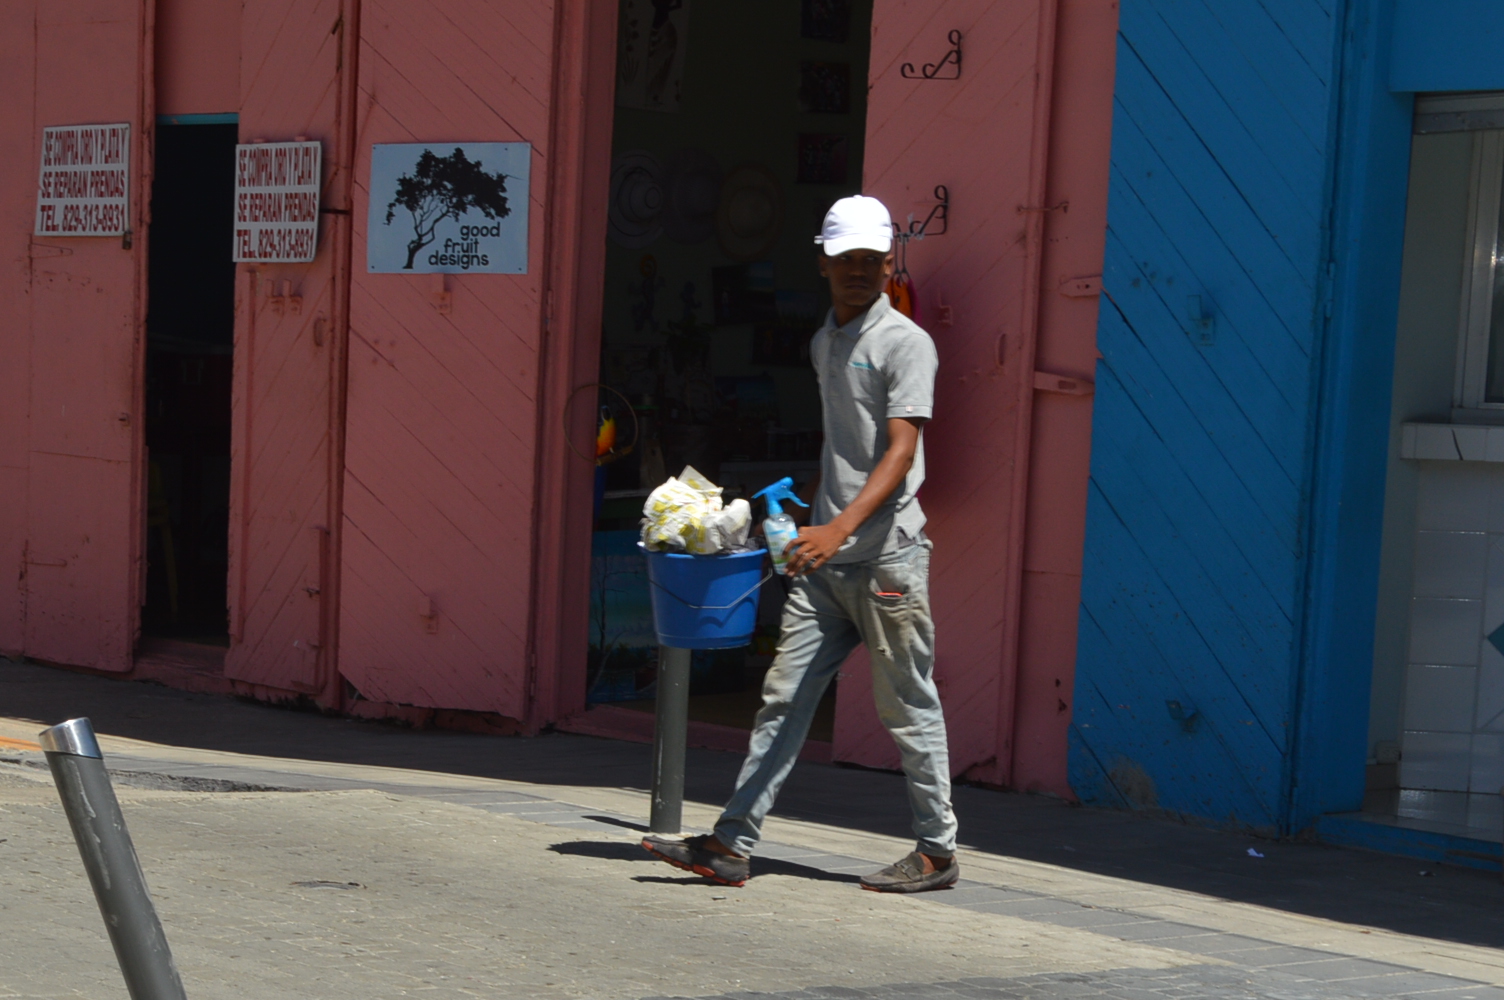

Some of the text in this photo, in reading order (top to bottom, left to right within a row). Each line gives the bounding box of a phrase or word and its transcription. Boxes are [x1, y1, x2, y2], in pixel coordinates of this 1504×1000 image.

[44, 131, 54, 166] SE
[54, 130, 79, 166] COMPRA
[80, 129, 93, 165] ORO
[100, 128, 120, 164] PLATA
[238, 149, 247, 187] SE
[248, 148, 273, 187] COMPRA
[275, 147, 286, 186] ORO
[294, 146, 312, 186] PLATA
[42, 169, 125, 199] SE REPARAN PRENDAS
[40, 204, 125, 232] TEL. 829-313-8931
[238, 192, 316, 222] SE REPARAN PRENDAS
[236, 228, 314, 259] TEL. 829-313-8931
[444, 238, 479, 254] fruit
[460, 221, 500, 241] good
[428, 250, 489, 270] designs
